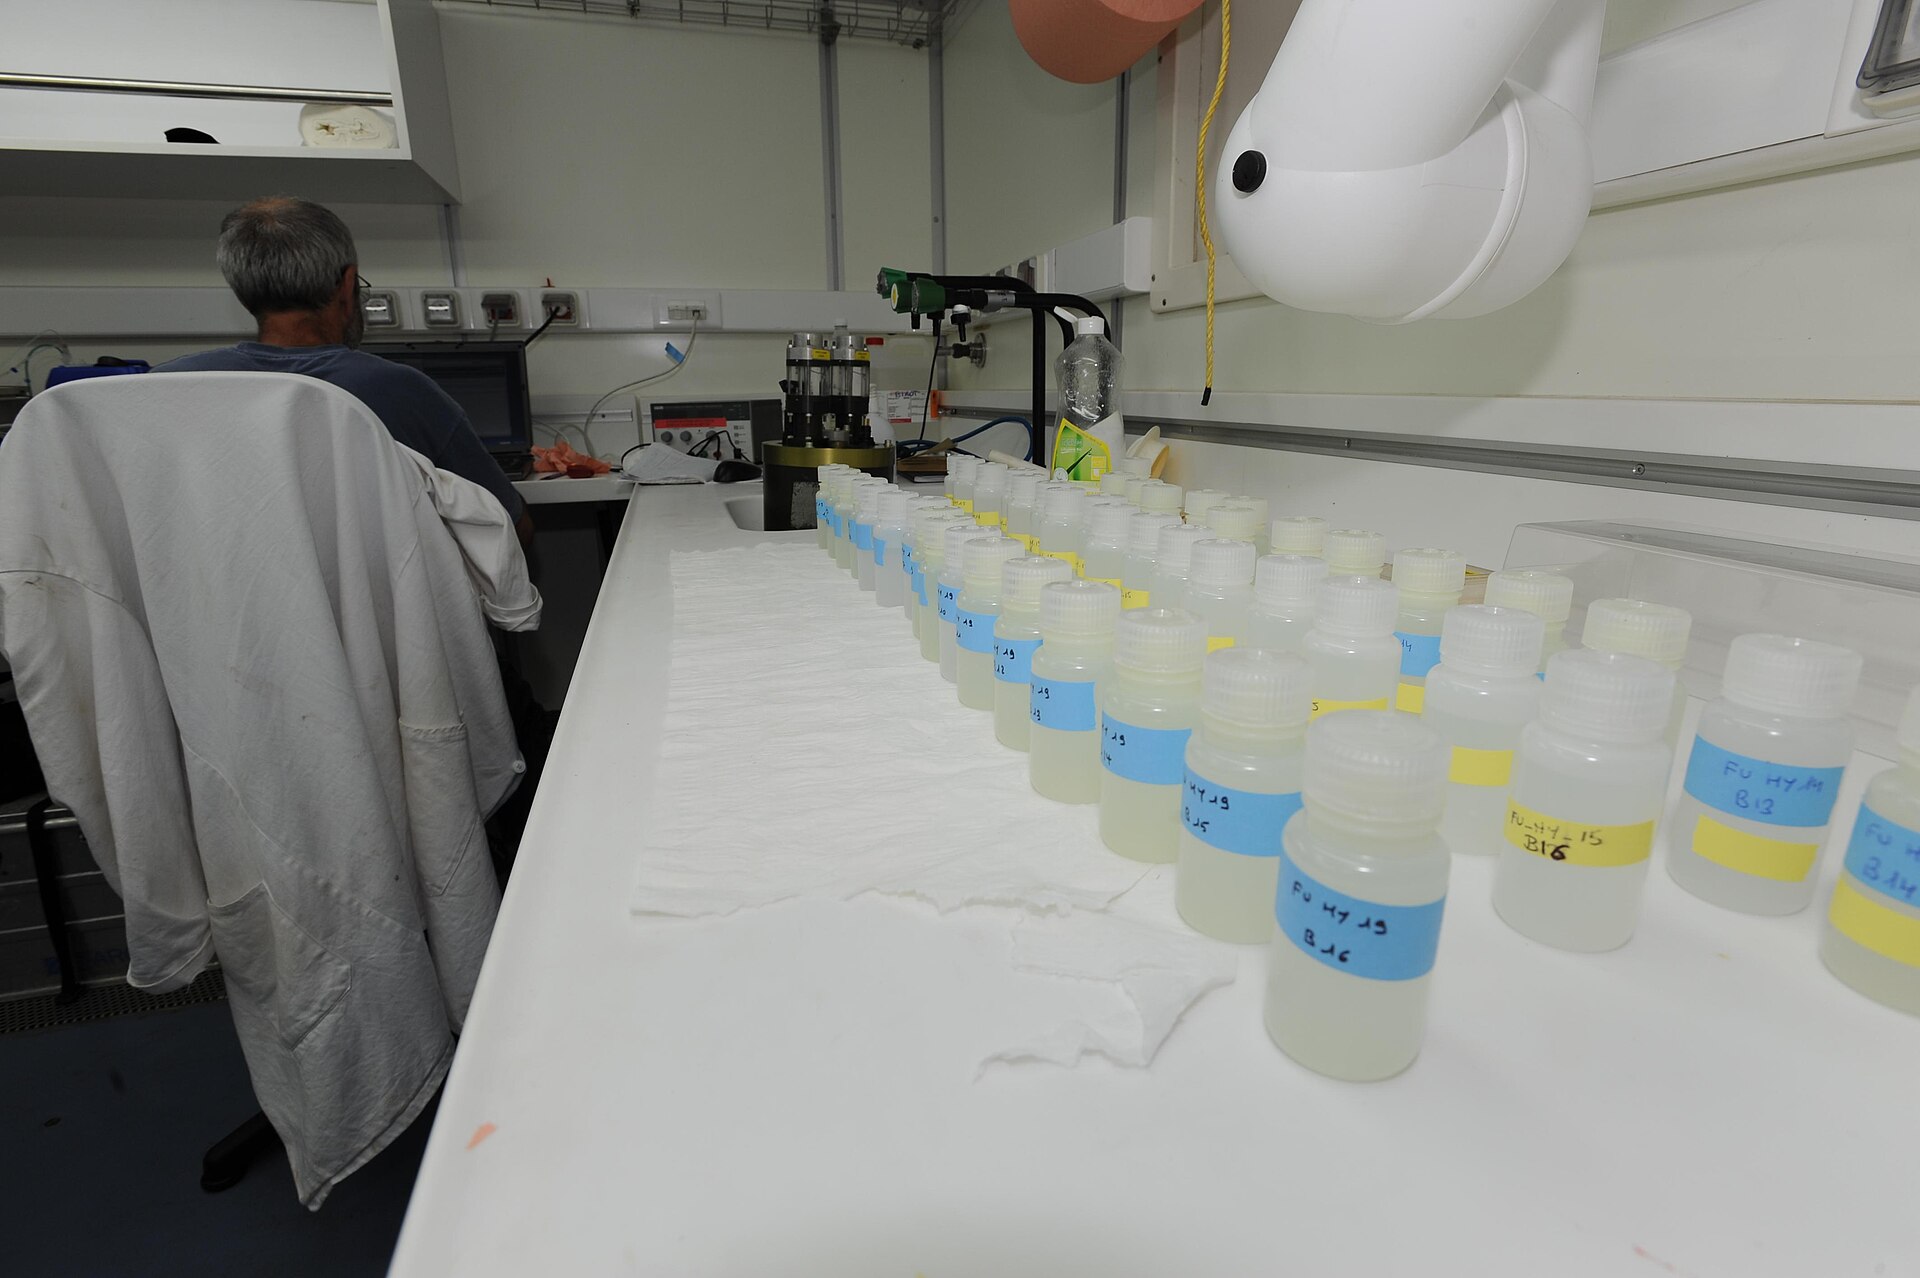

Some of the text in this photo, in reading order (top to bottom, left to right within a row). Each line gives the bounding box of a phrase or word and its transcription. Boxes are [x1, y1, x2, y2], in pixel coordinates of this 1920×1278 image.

[1003, 648, 1015, 660] 19
[1038, 686, 1050, 700] 19
[1111, 732, 1126, 746] 19
[1208, 795, 1230, 811] 19
[1357, 916, 1388, 936] 19
